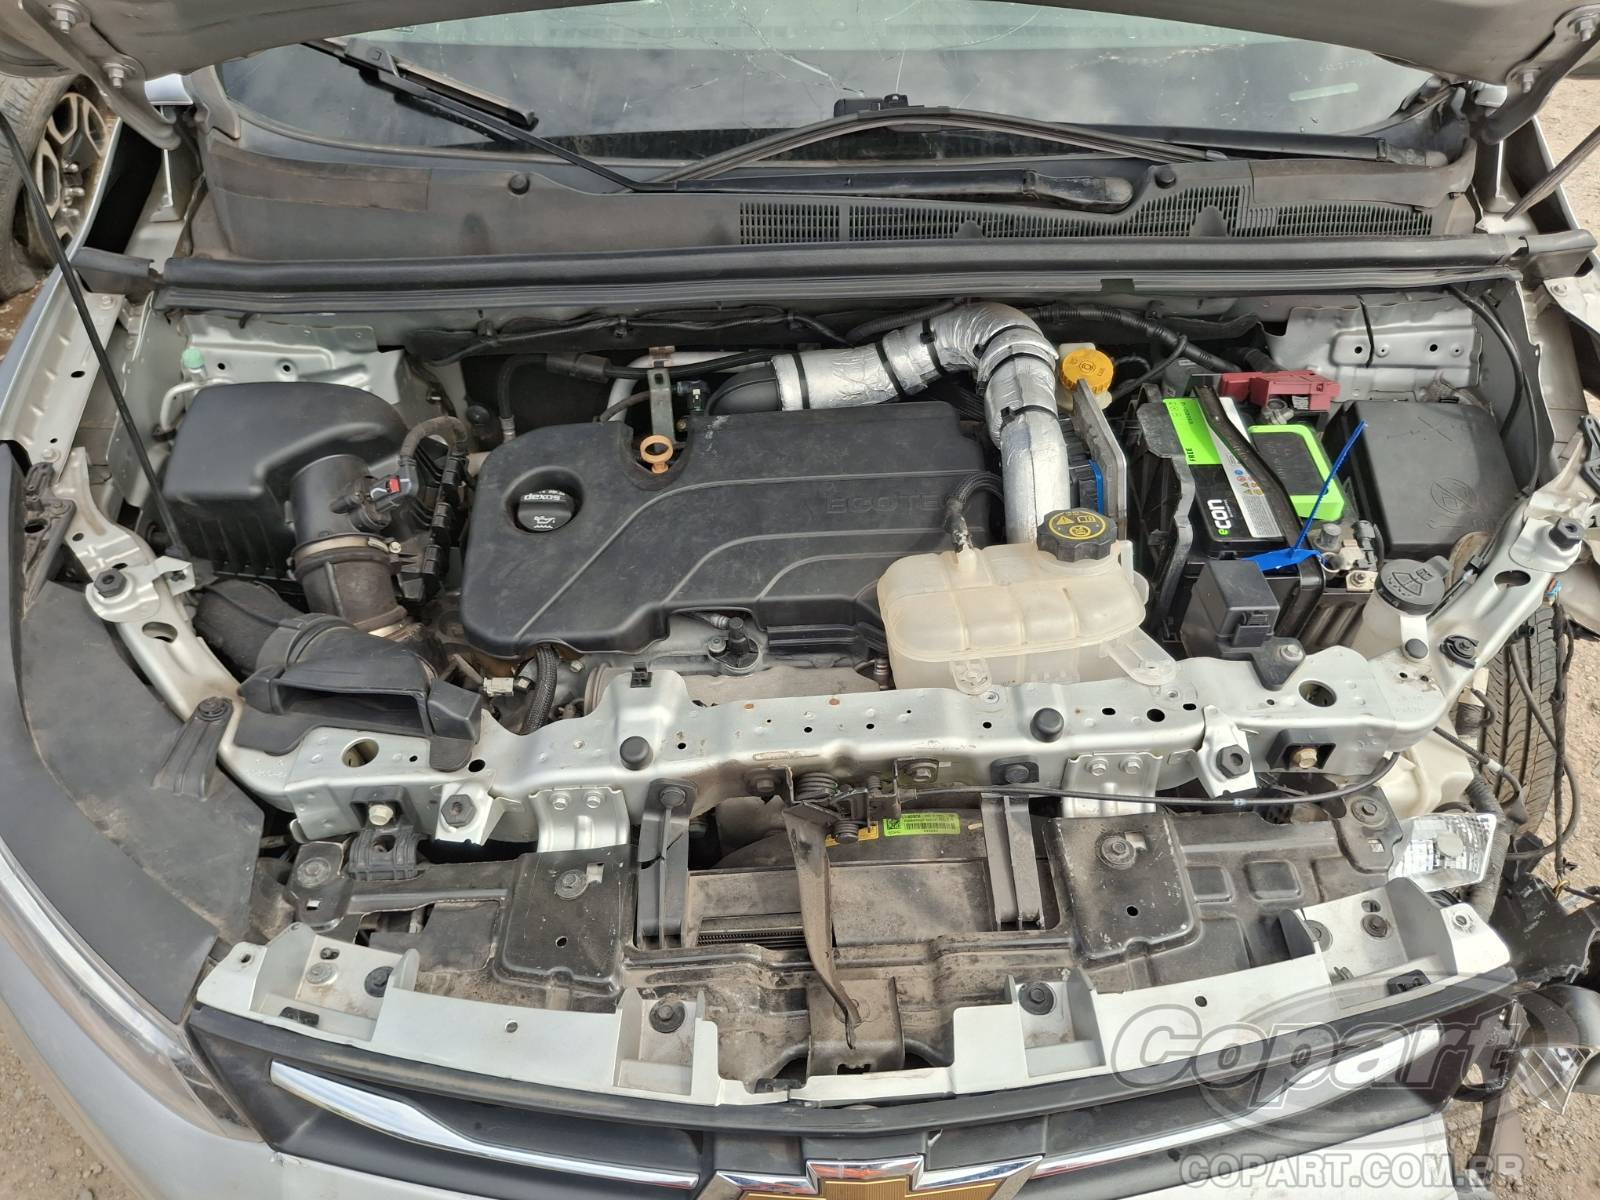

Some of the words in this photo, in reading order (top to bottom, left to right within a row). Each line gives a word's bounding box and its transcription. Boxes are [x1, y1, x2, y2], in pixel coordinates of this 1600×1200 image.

[1186, 448, 1196, 462] FREE
[524, 493, 560, 501] dexos
[1207, 499, 1232, 536] econ
